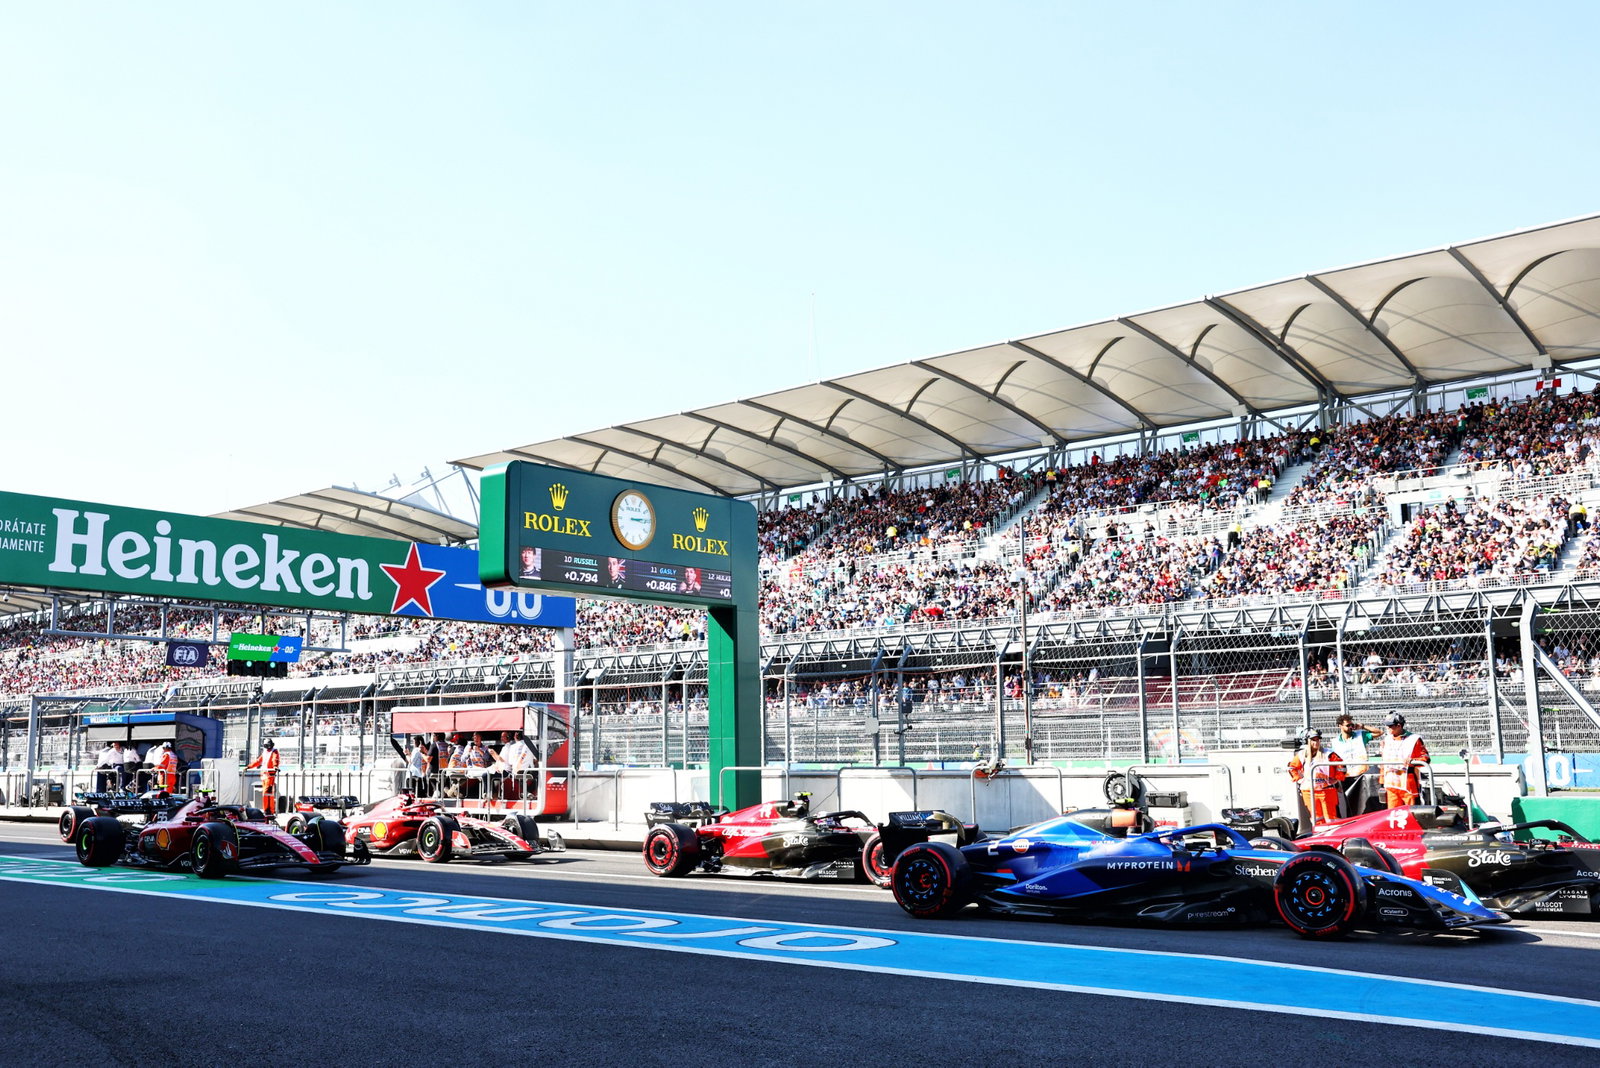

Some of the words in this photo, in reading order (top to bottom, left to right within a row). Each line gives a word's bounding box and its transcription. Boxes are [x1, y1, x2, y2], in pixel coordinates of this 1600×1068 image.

[524, 511, 592, 538] ROLEX
[672, 533, 728, 556] ROLEX
[48, 507, 373, 601] Heineken
[564, 555, 572, 563] 10
[573, 557, 598, 566] RUSSELL
[564, 571, 598, 583] +0.794
[660, 567, 677, 575] GASLY
[646, 580, 677, 592] +0.846
[238, 643, 271, 652] Heineken
[83, 791, 125, 799] PETROAS
[783, 834, 808, 848] Stake
[1467, 848, 1511, 867] Stake
[1107, 861, 1174, 870] MYPROTEIN
[1234, 864, 1279, 878] Stephens
[1378, 887, 1413, 897] Acronis
